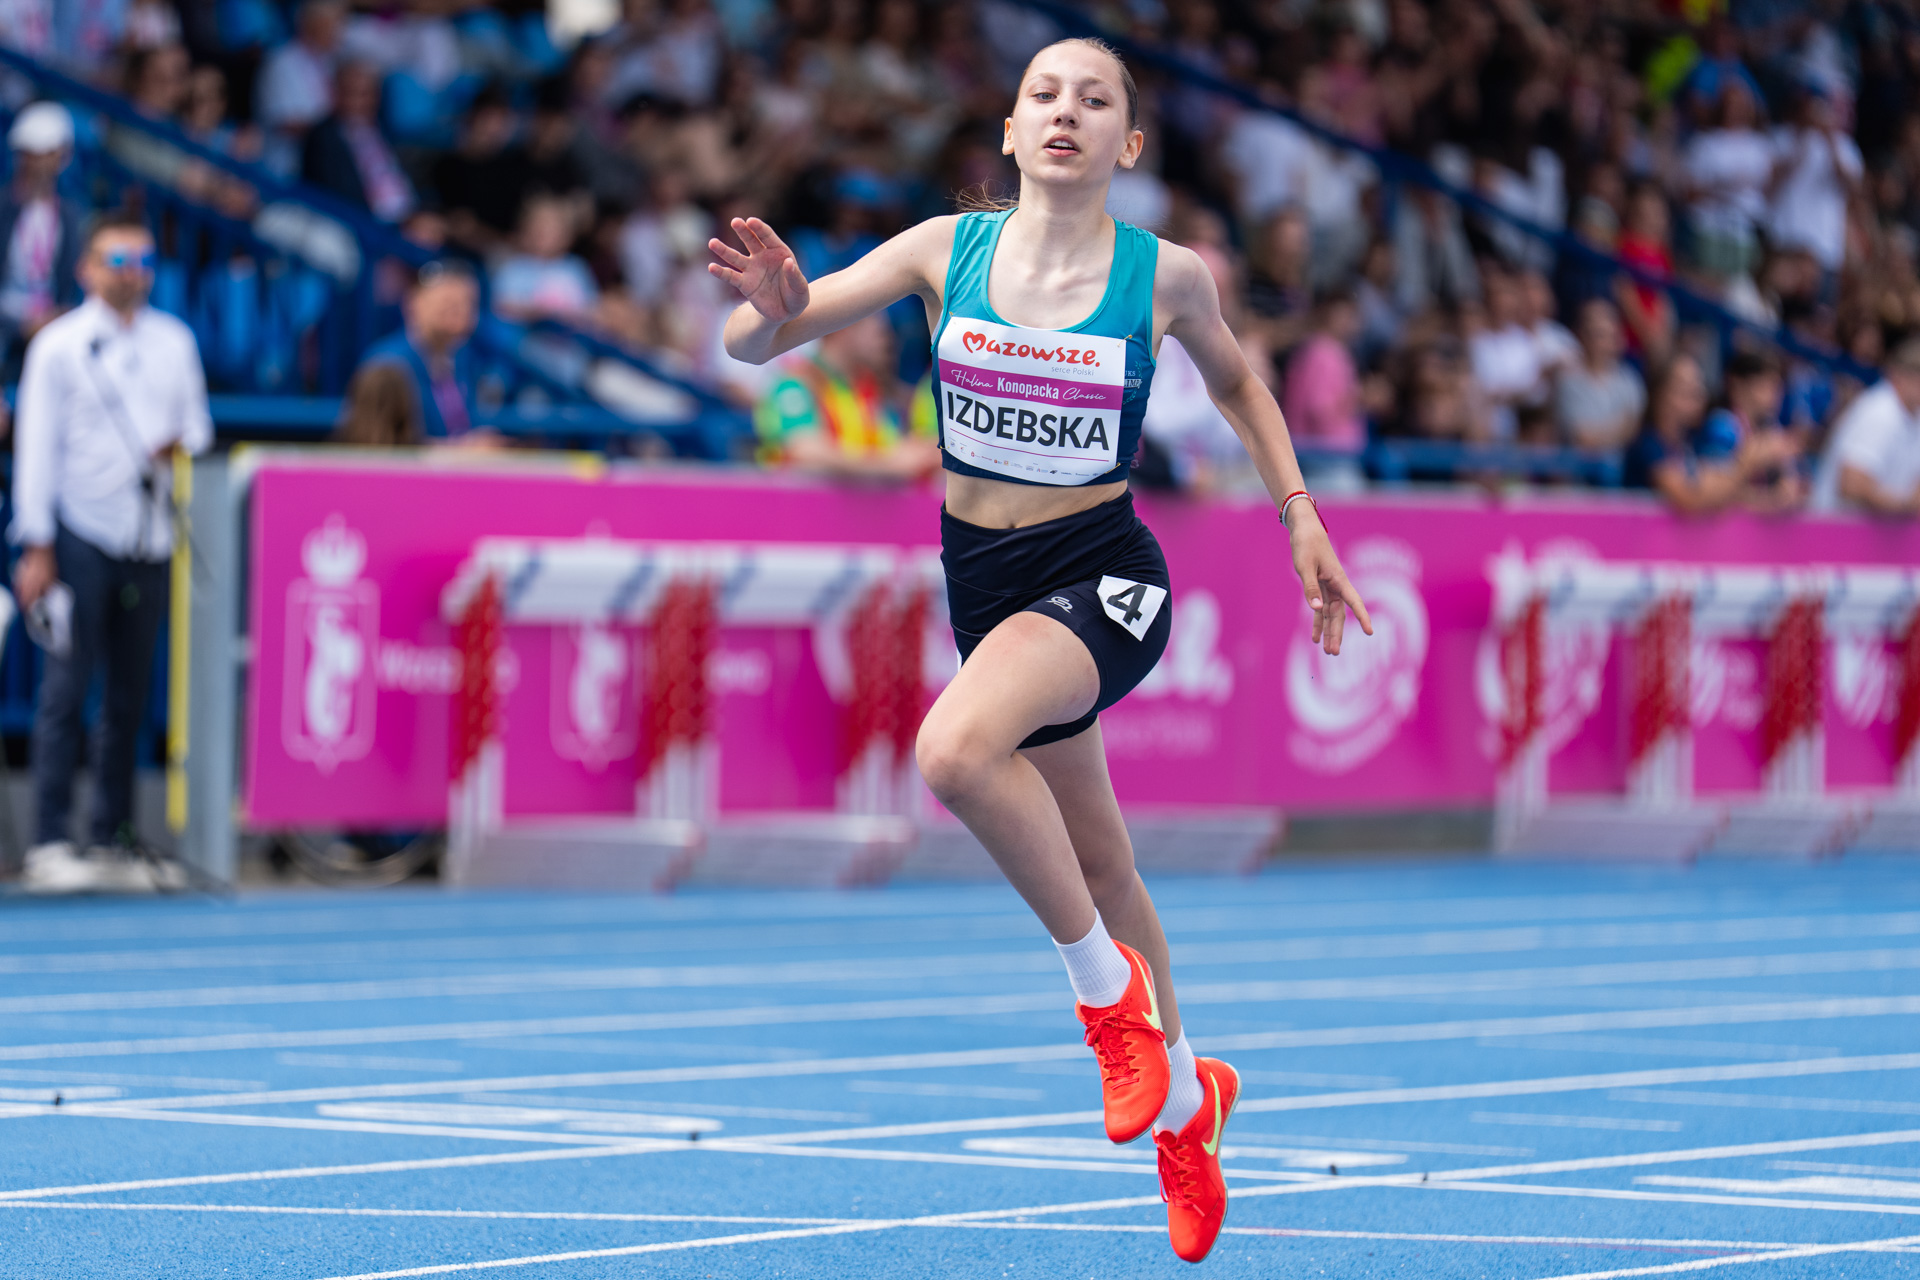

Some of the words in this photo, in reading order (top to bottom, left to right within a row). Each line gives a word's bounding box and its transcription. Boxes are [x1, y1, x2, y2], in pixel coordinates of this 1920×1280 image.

[951, 369, 993, 387] Halina
[997, 377, 1059, 400] Konopacka
[1062, 387, 1107, 401] Classic
[1051, 366, 1071, 374] serce
[1072, 367, 1095, 376] Polski
[947, 391, 1110, 451] IZDEBSKA
[1106, 583, 1148, 626] 4
